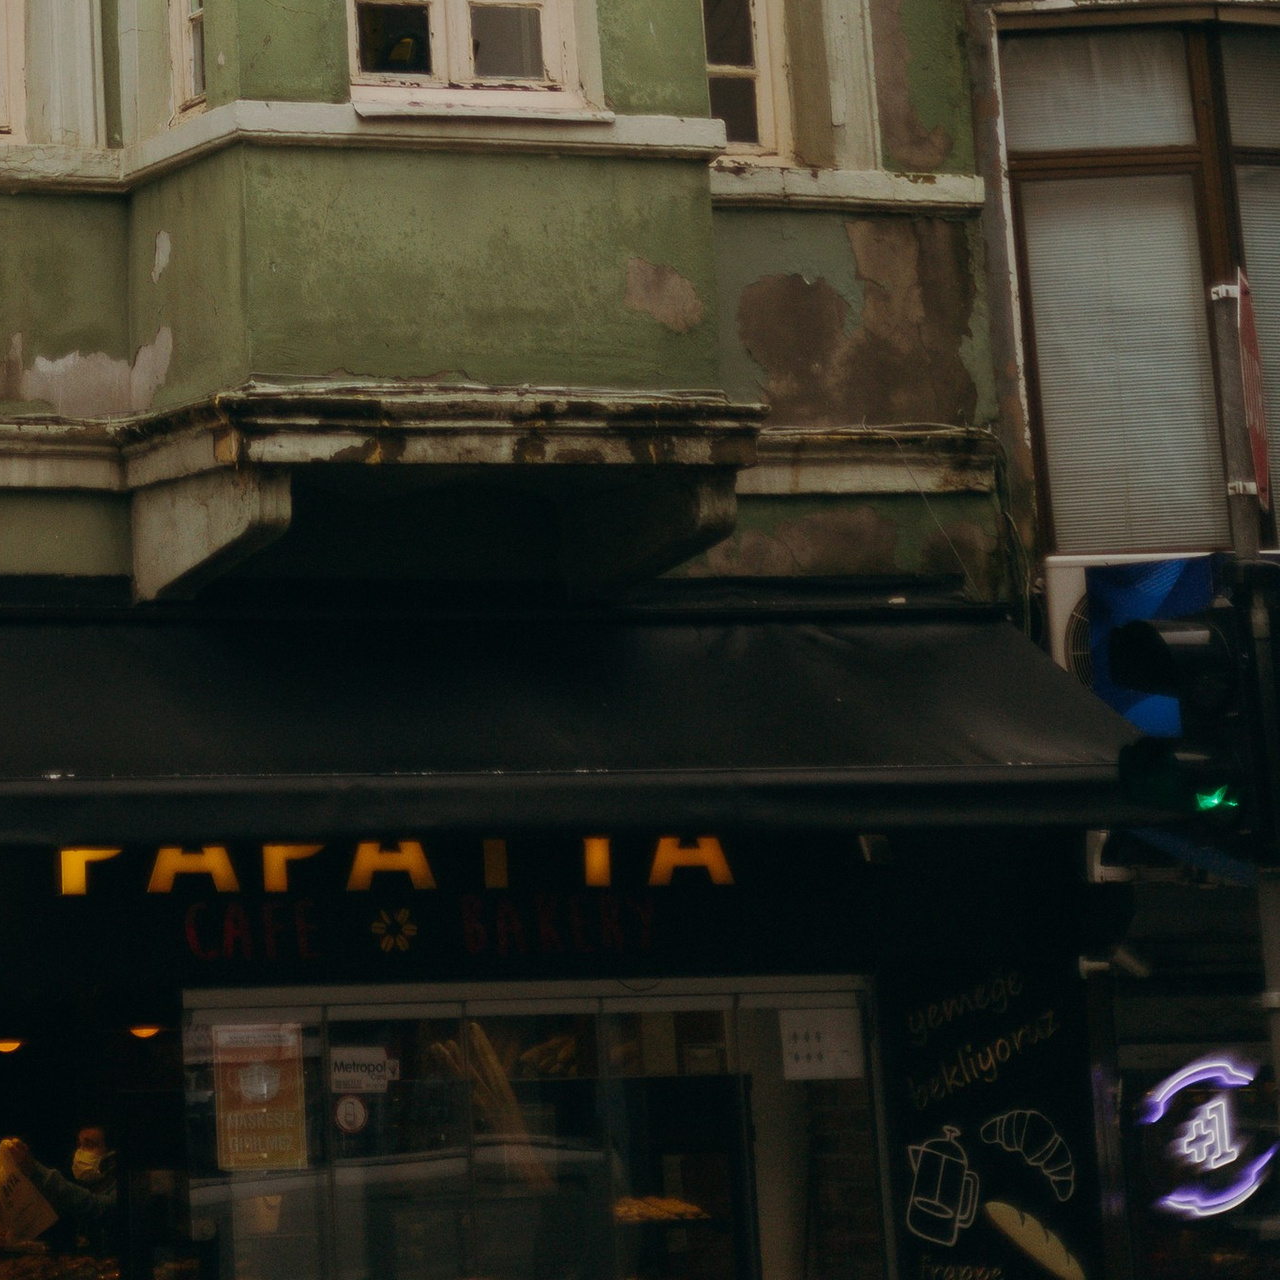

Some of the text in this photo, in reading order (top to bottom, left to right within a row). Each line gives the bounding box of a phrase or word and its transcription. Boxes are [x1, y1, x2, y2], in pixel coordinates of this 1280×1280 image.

[184, 893, 656, 961] CAFE BAKERY
[334, 1060, 386, 1076] Metropol
[908, 1009, 1061, 1110] bekliyoruz
[1183, 1101, 1238, 1170] +1
